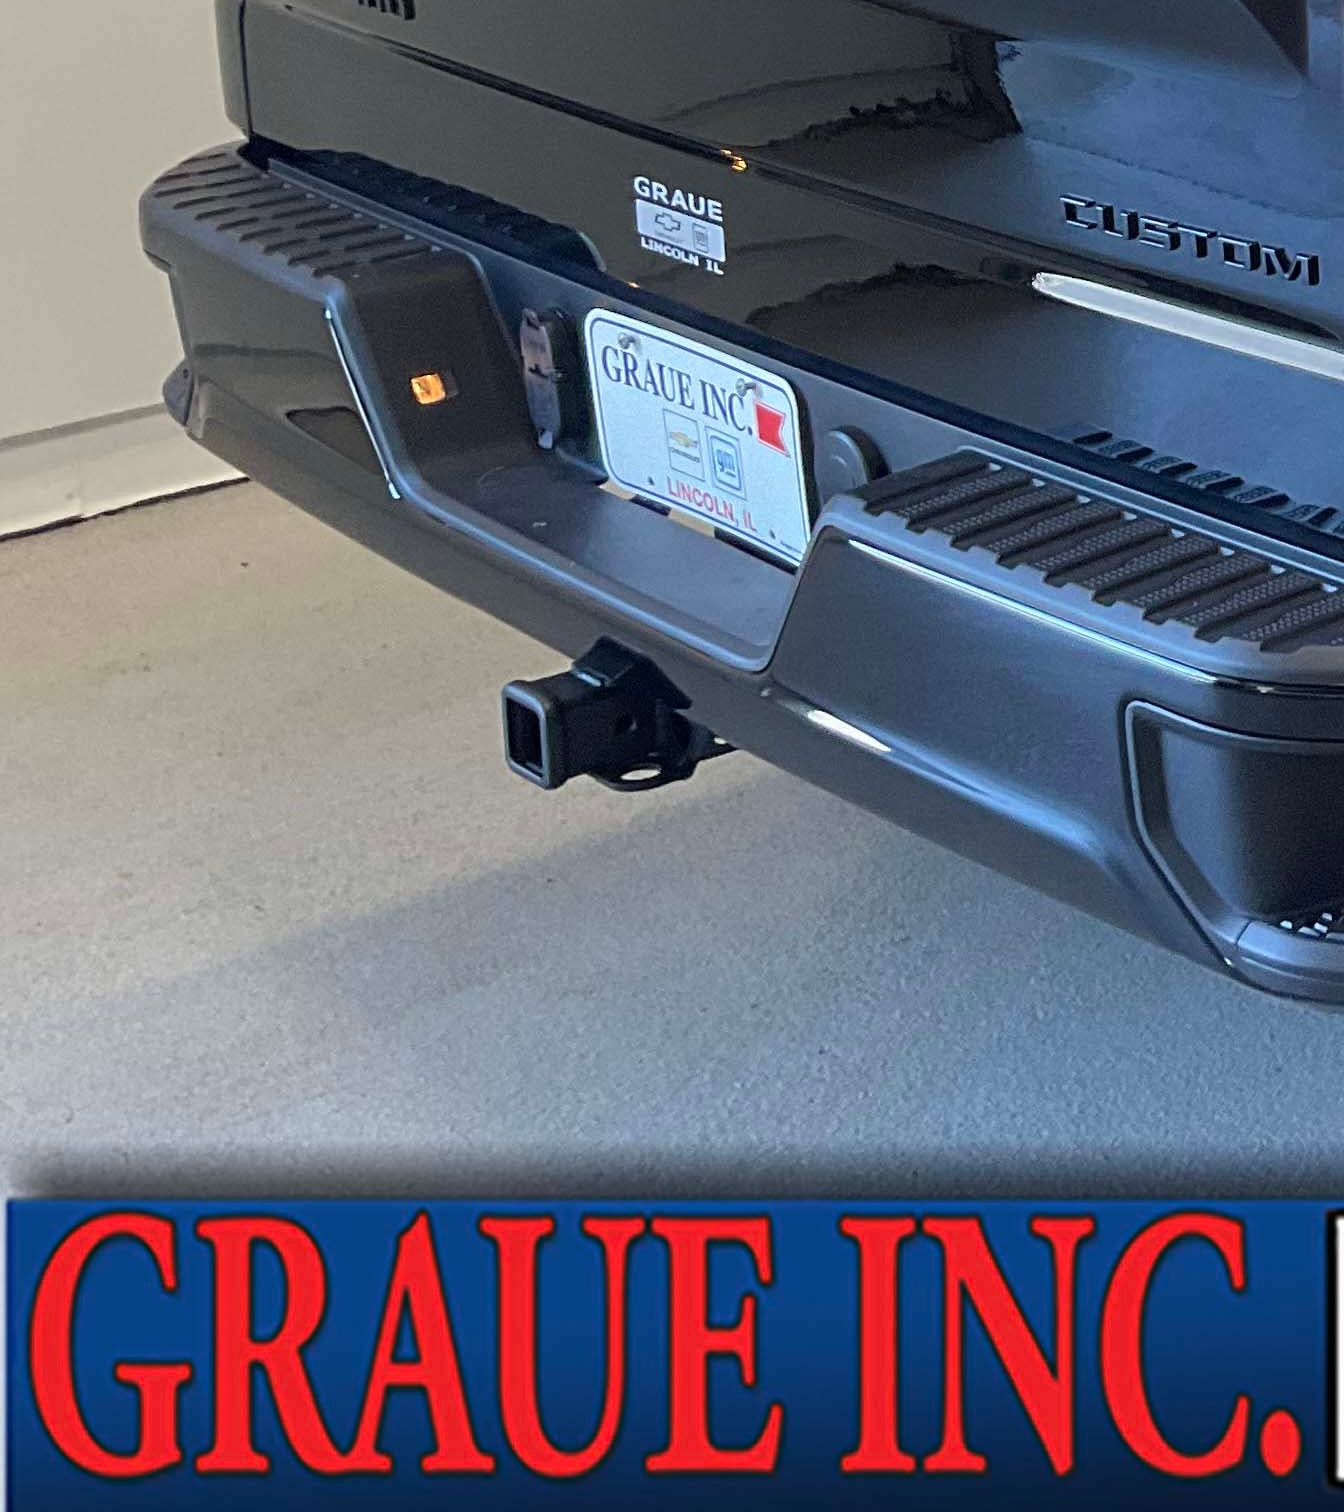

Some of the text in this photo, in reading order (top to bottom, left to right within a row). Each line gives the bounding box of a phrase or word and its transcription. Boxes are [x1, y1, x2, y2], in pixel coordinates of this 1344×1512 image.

[633, 176, 724, 222] GRAUE
[640, 236, 700, 267] LINCOLN
[705, 258, 725, 276] IL
[1059, 193, 1320, 286] CUSTOM
[601, 344, 754, 436] GRAUE INC.
[666, 475, 758, 532] LINCOLN, IL
